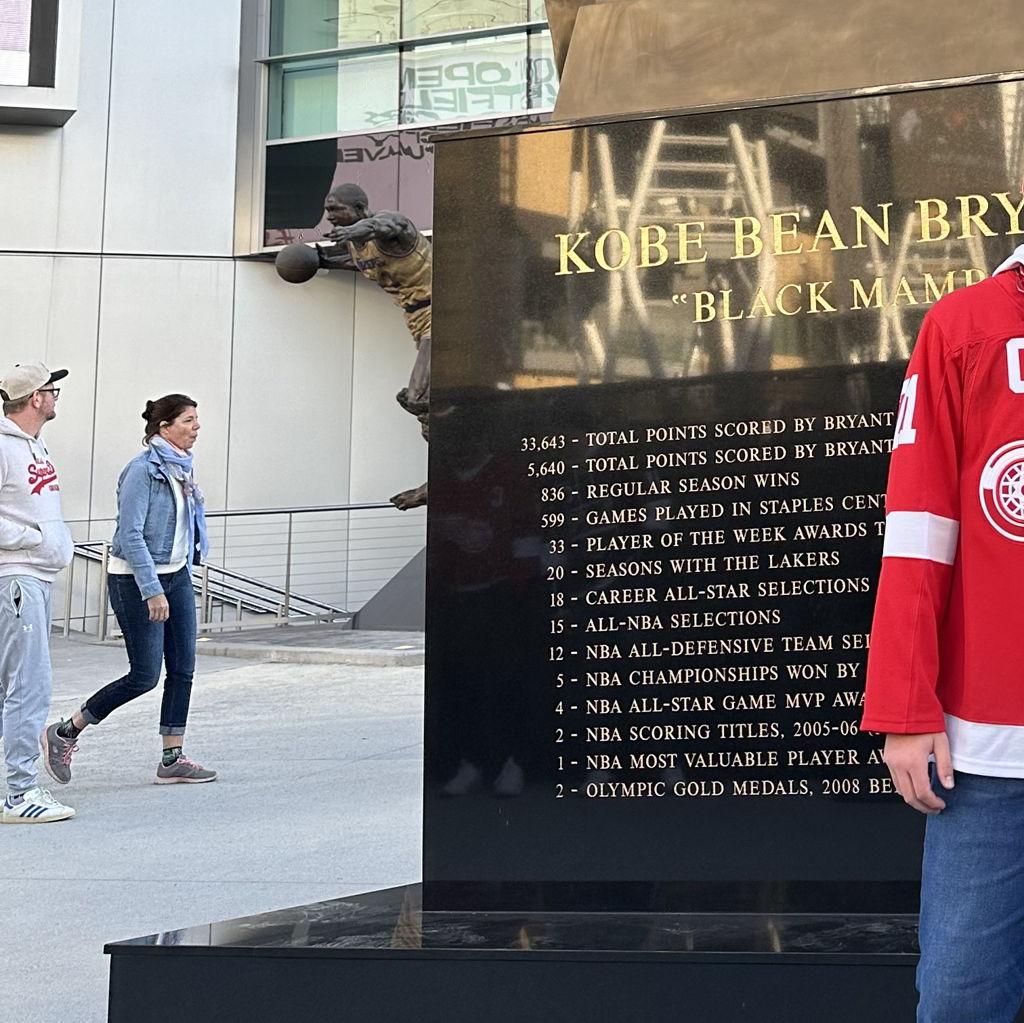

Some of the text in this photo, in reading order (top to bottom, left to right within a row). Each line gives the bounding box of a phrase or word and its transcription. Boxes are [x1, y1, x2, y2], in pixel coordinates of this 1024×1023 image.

[555, 220, 708, 276] KOBE
[730, 202, 894, 260] BEAN
[520, 434, 566, 452] 33,643
[585, 430, 640, 447] TOTAL
[645, 424, 707, 443] POINTS
[714, 419, 787, 438] SCORED
[793, 416, 817, 433] BY
[823, 411, 896, 431] BRYANT
[527, 460, 566, 478] 5,640
[585, 455, 640, 473] TOTAL
[645, 450, 708, 469] POINTS
[715, 445, 787, 464] SCORED
[794, 443, 818, 459] BY
[824, 438, 895, 459] BRYANT
[541, 486, 565, 502] 836
[586, 479, 672, 499] REGULAR
[678, 474, 747, 493] SEASON
[753, 471, 800, 488] WINS
[540, 513, 565, 529] 599
[585, 507, 648, 526] GAMES
[654, 503, 725, 522] PLAYED
[731, 501, 752, 517] IN
[759, 496, 834, 515] STAPLES
[549, 539, 565, 555] 33
[586, 534, 655, 552] PLAYER
[660, 532, 684, 548] OF
[689, 529, 726, 546] THE
[732, 526, 787, 543] WEEK
[792, 522, 867, 541] AWARDS
[546, 565, 565, 581] 20
[585, 560, 663, 579] SEASONS
[669, 557, 717, 574] WITH
[723, 554, 760, 572] THE
[767, 550, 840, 569] LAKERS
[550, 592, 564, 608] 18
[585, 587, 658, 606] CAREER
[663, 582, 751, 602] ALL-STAR
[757, 576, 870, 597] SELECTIONS
[550, 619, 564, 634] 15
[584, 615, 664, 633] ALL-NBA
[670, 609, 781, 629] SELECTIONS
[549, 646, 564, 661] 12
[585, 644, 623, 660] NBA
[627, 637, 774, 658] ALL-DEFENSIVE
[781, 634, 834, 652] TEAM
[556, 673, 564, 688] 5
[585, 671, 623, 687] NBA
[628, 665, 779, 686] CHAMPIONSHIPS
[785, 663, 828, 680] WON
[836, 662, 860, 679] BY
[554, 701, 564, 715] 4
[586, 699, 623, 715] NBA
[628, 695, 716, 714] ALL-STAR
[722, 693, 777, 711] GAME
[784, 692, 826, 709] MVP
[555, 728, 564, 743] 2
[585, 726, 623, 742] NBA
[629, 724, 711, 742] SCORING
[717, 722, 785, 739] TITLES,
[793, 720, 858, 737] 2005-06
[558, 756, 564, 771] 1
[586, 754, 623, 770] NBA
[629, 753, 678, 770] MOST
[683, 751, 779, 768] VALUABLE
[787, 749, 861, 766] PLAYER
[555, 783, 564, 798] 2
[586, 781, 666, 798] OLYMPIC
[673, 780, 725, 797] GOLD
[732, 779, 814, 797] MEDALS,
[821, 778, 860, 795] 2008
[869, 776, 897, 794] BE
